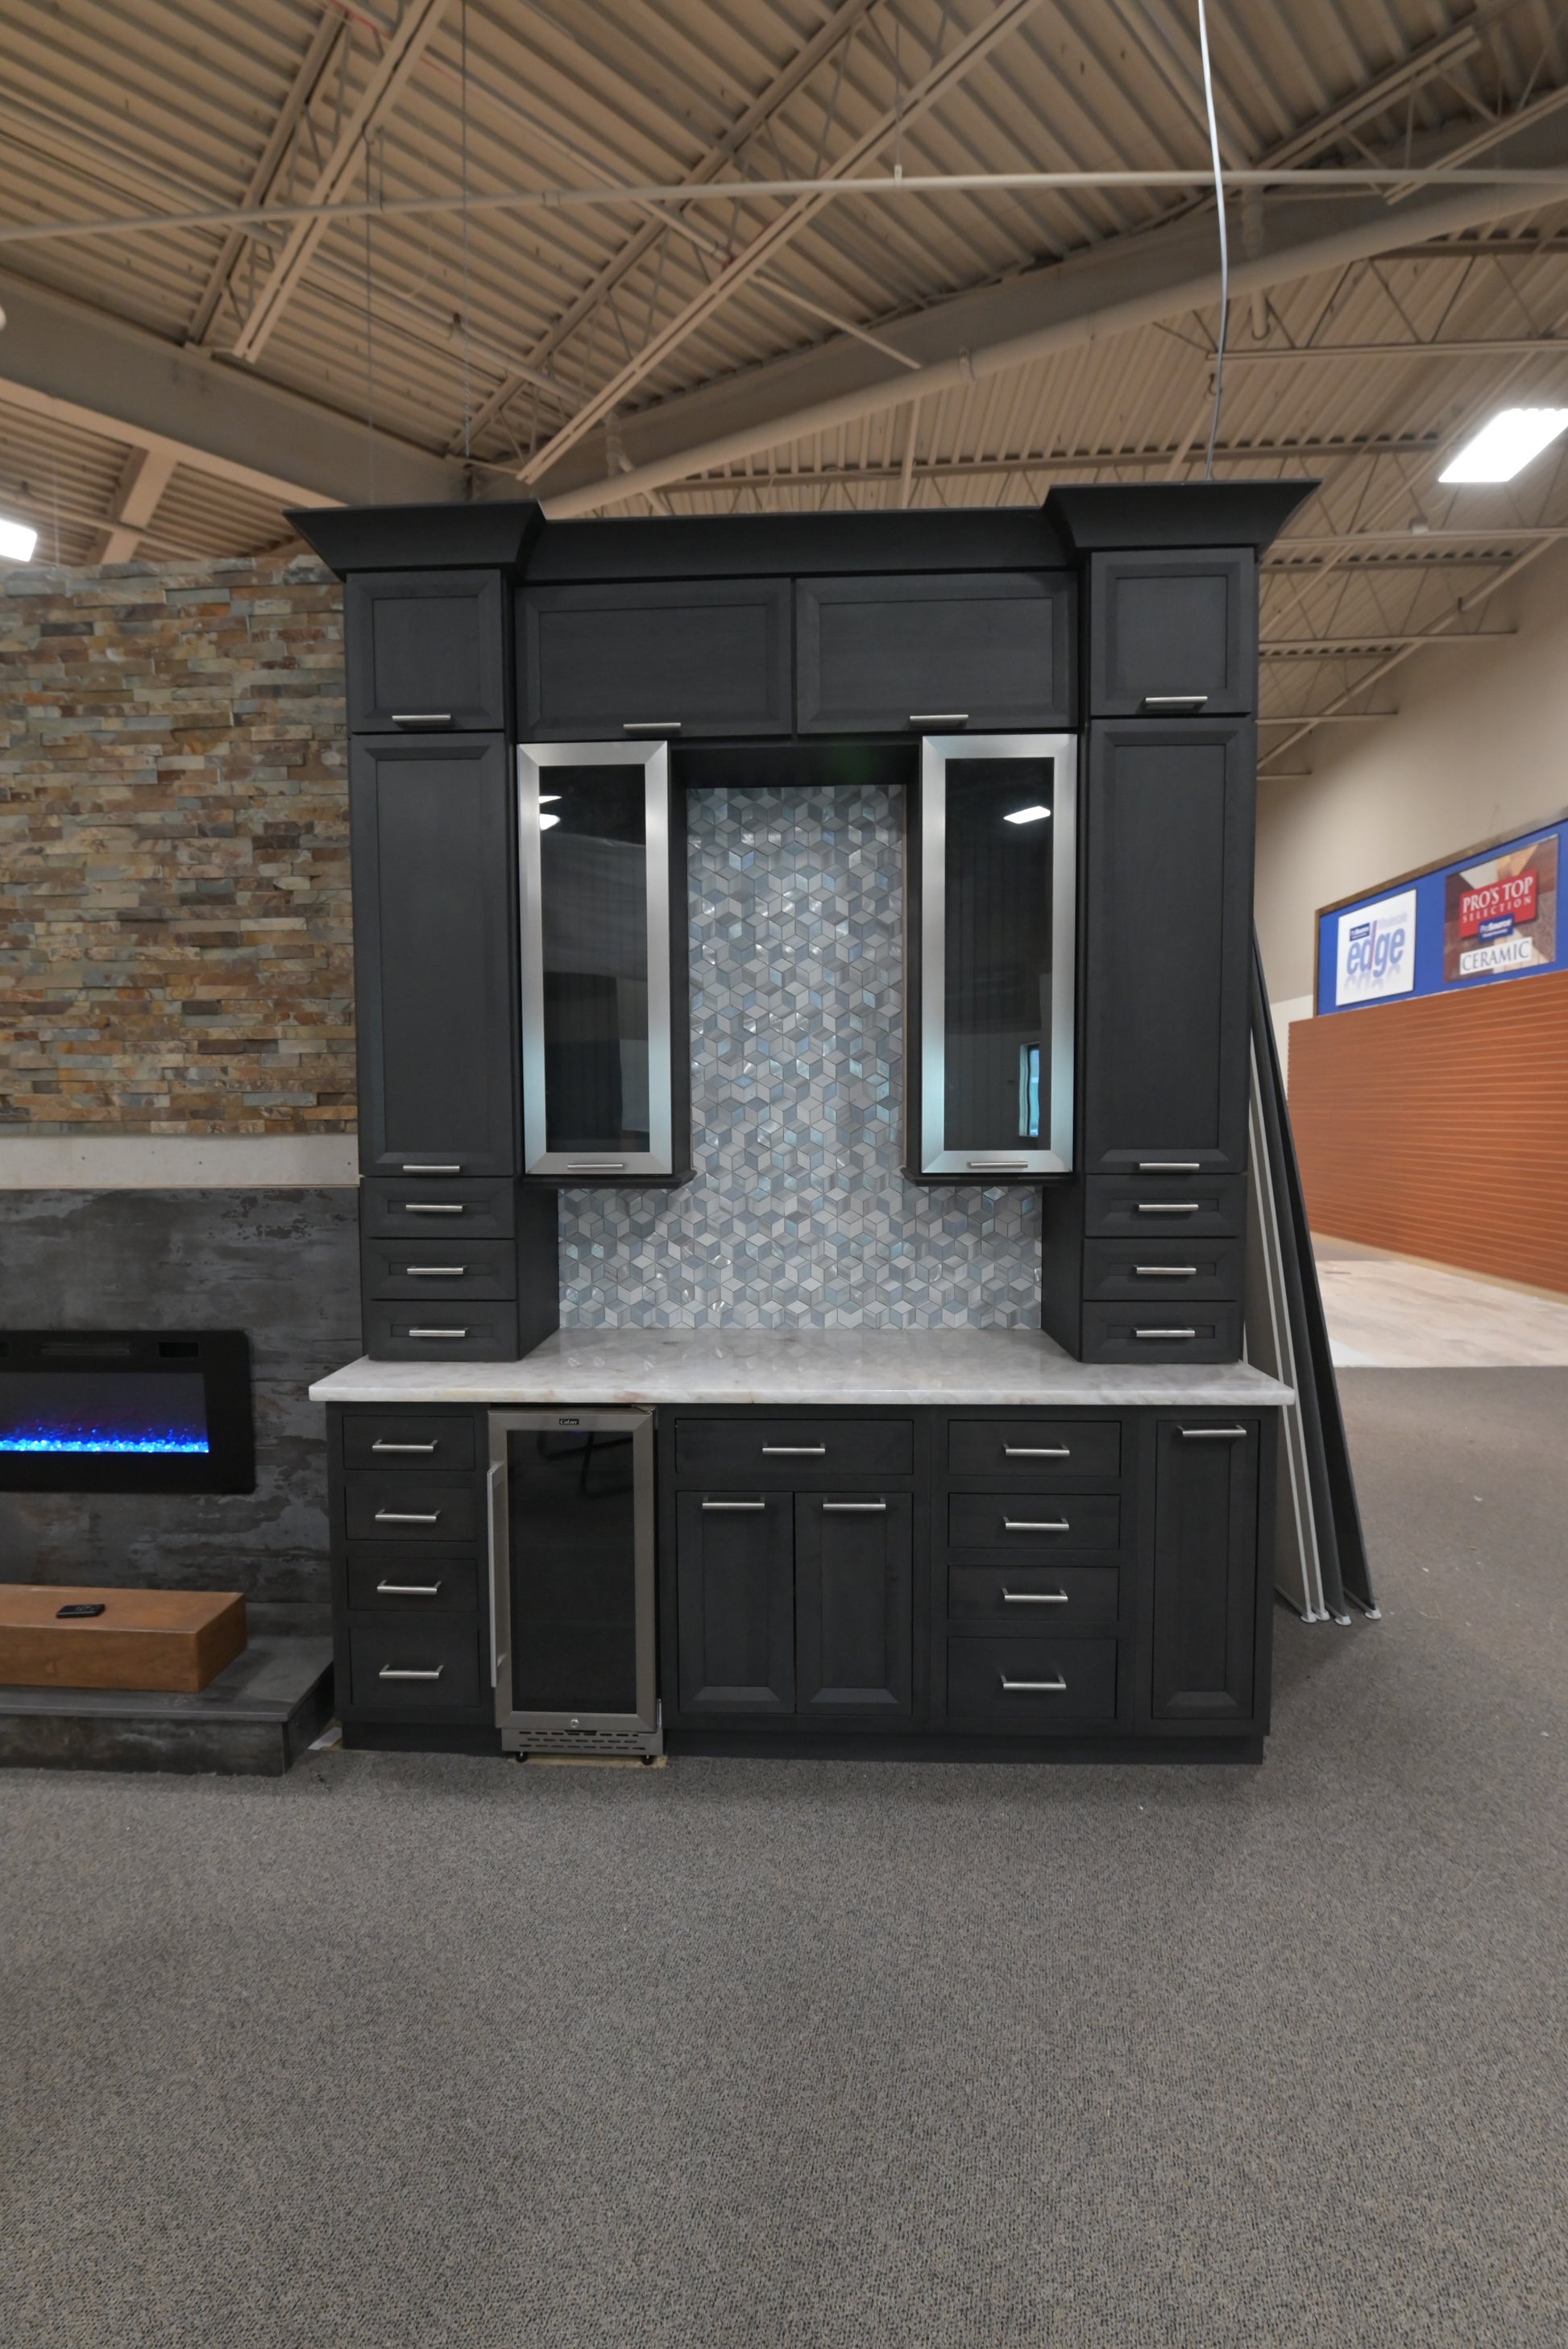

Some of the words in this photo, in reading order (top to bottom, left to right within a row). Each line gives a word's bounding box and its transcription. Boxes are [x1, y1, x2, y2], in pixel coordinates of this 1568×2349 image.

[1462, 886, 1500, 913] PRO'S
[1502, 876, 1533, 900] TOP
[1462, 895, 1531, 923] SELECTION
[1346, 920, 1405, 977] edge
[1462, 940, 1529, 970] CERAMIC
